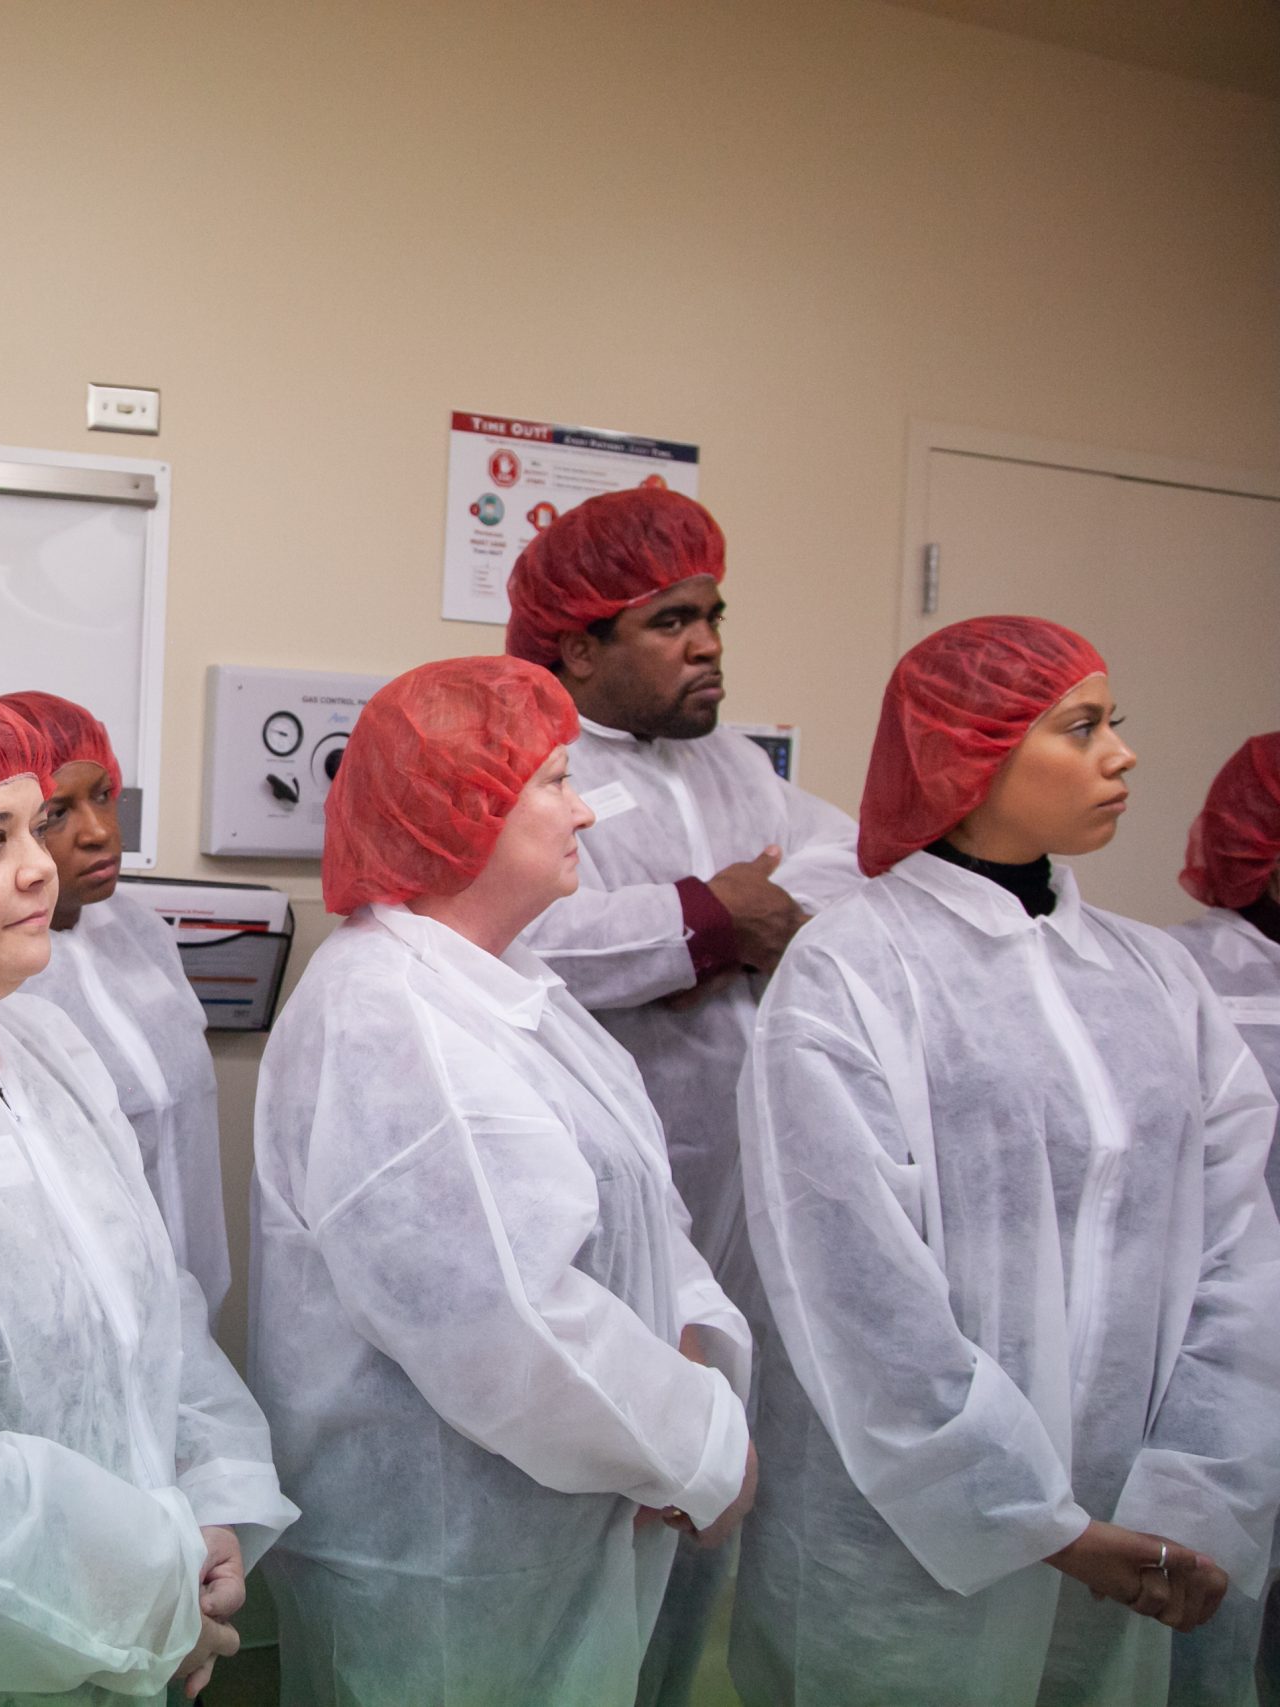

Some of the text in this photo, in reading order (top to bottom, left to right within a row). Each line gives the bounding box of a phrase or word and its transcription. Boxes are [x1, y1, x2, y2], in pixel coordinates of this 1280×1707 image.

[472, 416, 548, 440] TIME OUT!
[302, 695, 318, 704] GAS
[320, 696, 356, 705] CONTROL
